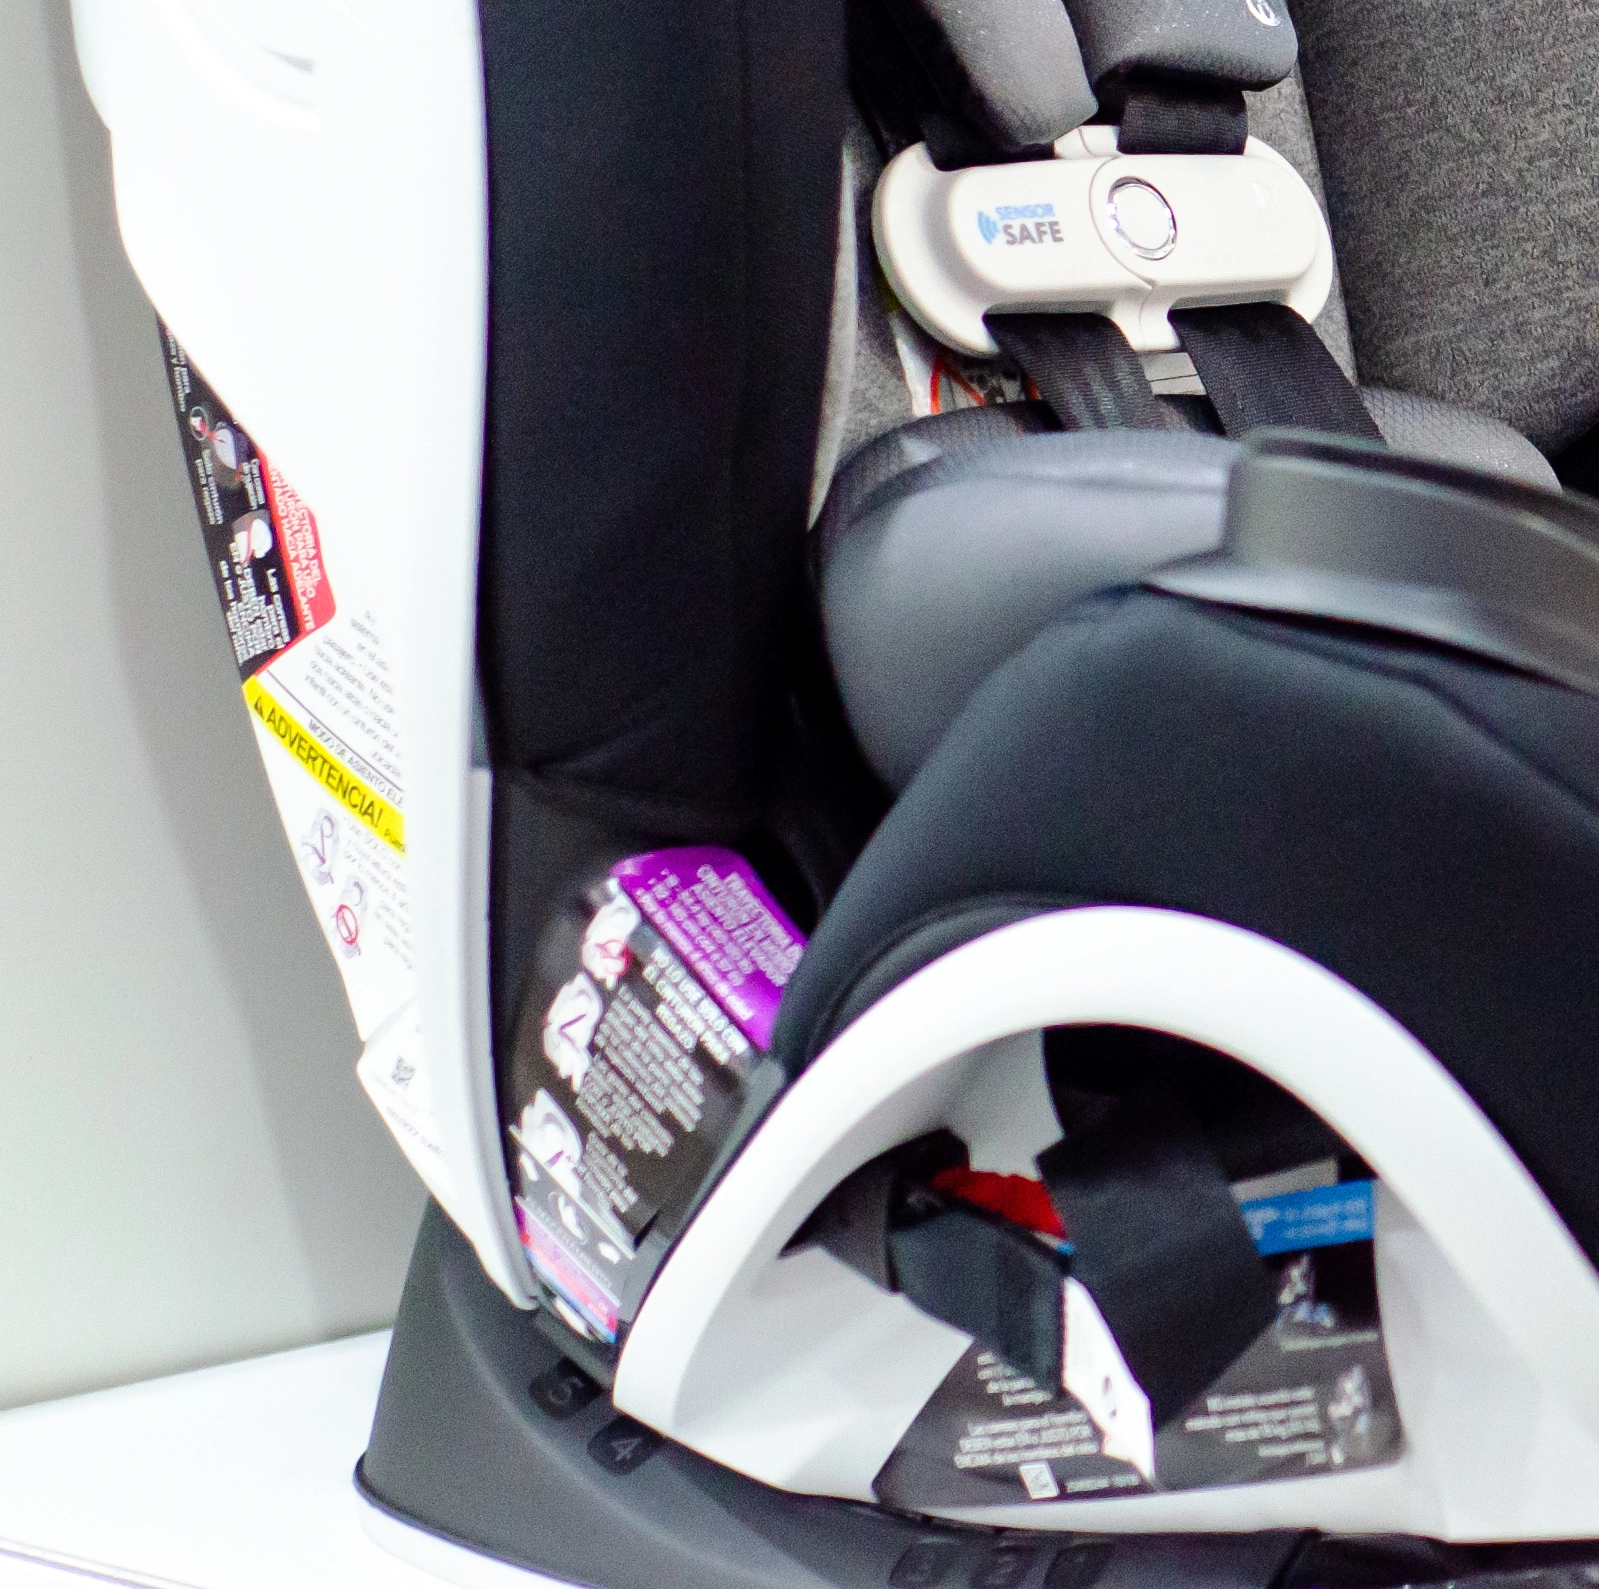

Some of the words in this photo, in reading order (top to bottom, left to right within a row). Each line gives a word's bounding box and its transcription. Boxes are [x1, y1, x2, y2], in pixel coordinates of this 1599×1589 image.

[995, 203, 1055, 221] SENSOR
[1002, 220, 1065, 246] SAFE
[289, 560, 315, 630] ADELANTE
